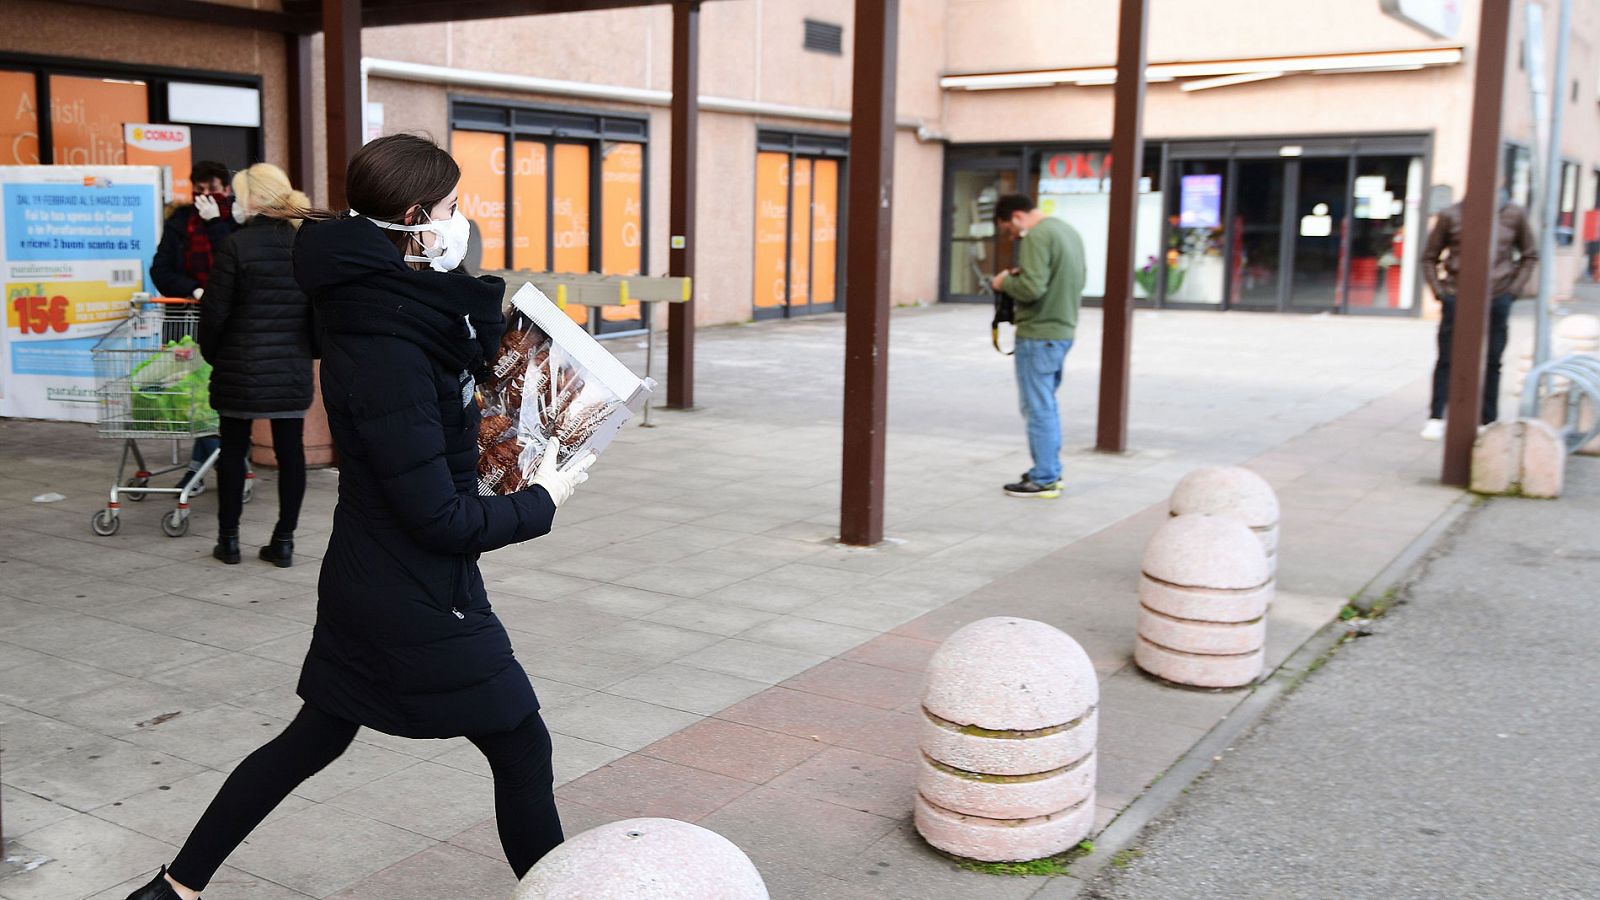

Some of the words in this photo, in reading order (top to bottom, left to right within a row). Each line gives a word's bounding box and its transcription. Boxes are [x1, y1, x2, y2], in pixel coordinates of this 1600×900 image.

[144, 129, 184, 142] CONAD
[61, 239, 84, 249] buoni
[88, 240, 115, 250] sconto
[118, 240, 128, 249] da
[13, 295, 69, 334] 15€
